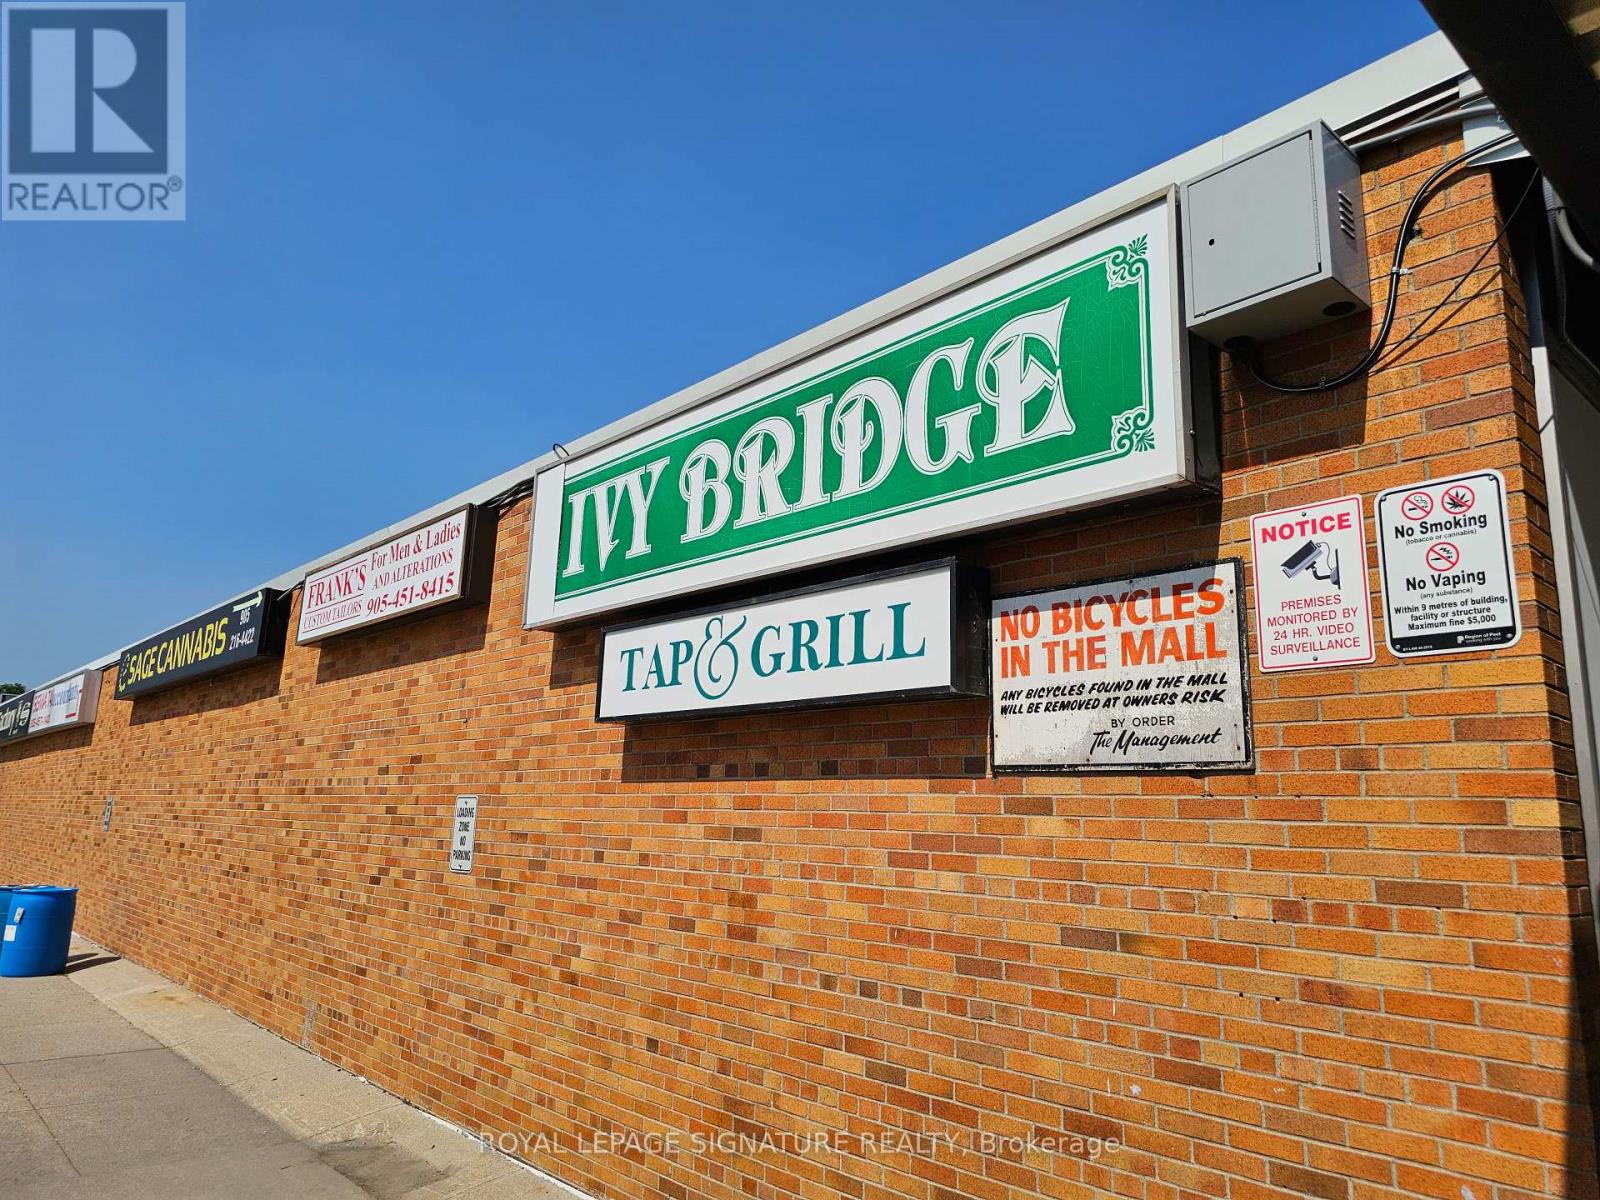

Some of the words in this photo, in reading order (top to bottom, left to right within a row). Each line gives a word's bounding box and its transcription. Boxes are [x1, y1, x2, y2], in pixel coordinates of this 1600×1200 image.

[563, 457, 669, 577] IVY
[680, 296, 1075, 544] BRIDGE
[1261, 512, 1352, 543] NOTICE
[1394, 525, 1415, 539] No
[1420, 514, 1488, 535] Smoking
[371, 552, 387, 571] For
[389, 542, 410, 564] Men
[413, 534, 423, 555] &
[426, 521, 461, 550] Ladies
[372, 572, 390, 591] AND
[391, 547, 455, 584] ALTERATIONS
[1406, 577, 1426, 591] No
[1431, 570, 1486, 588] Vaping
[307, 563, 367, 609] FRANK'S
[366, 571, 455, 617] 905-451-8415
[1436, 587, 1473, 597] substance)
[1000, 605, 1041, 642] NO
[1051, 578, 1225, 635] BICYCLES
[1281, 594, 1342, 611] PREMISES
[1394, 605, 1419, 615] Within
[1421, 603, 1427, 611] 9
[1429, 600, 1458, 611] metres
[1460, 597, 1469, 606] of
[1471, 594, 1508, 605] building,
[1411, 611, 1439, 622] facility
[1451, 606, 1492, 617] structure
[1267, 609, 1337, 628] MONITORED
[1343, 607, 1358, 619] BY
[1408, 621, 1448, 631] Maximum
[1449, 619, 1465, 627] fine
[1467, 614, 1497, 624] $5,000
[1273, 630, 1288, 641] 24
[1293, 627, 1312, 640] HR.
[1317, 622, 1354, 637] VIDEO
[127, 645, 158, 685] SAGE
[157, 617, 229, 675] CANNABIS
[620, 639, 694, 692] TAP
[694, 615, 747, 700] &
[750, 602, 926, 678] GRILL
[1001, 644, 1030, 679] IN
[1042, 634, 1107, 674] THE
[1120, 621, 1228, 668] MALL
[1270, 636, 1361, 656] SURVEILLANCE
[1001, 690, 1022, 701] ANY
[1025, 683, 1085, 700] BICYCLES
[1088, 679, 1133, 694] FOUND
[1136, 677, 1151, 690] IN
[1156, 675, 1184, 688] THE
[1187, 672, 1228, 686] MALL
[1001, 703, 1024, 716] WILL
[1027, 702, 1041, 713] BE
[1044, 699, 1100, 713] REMOVED
[1102, 696, 1120, 708] AT
[1123, 692, 1176, 708] OWNERS
[1180, 688, 1227, 704] RISK
[1111, 717, 1126, 728] BY
[1132, 715, 1175, 727] ORDER
[1089, 729, 1113, 756] The
[1113, 727, 1222, 756] Management
[457, 807, 475, 818] LOADING
[458, 821, 470, 832] ZONE
[453, 849, 471, 861] PARKING
